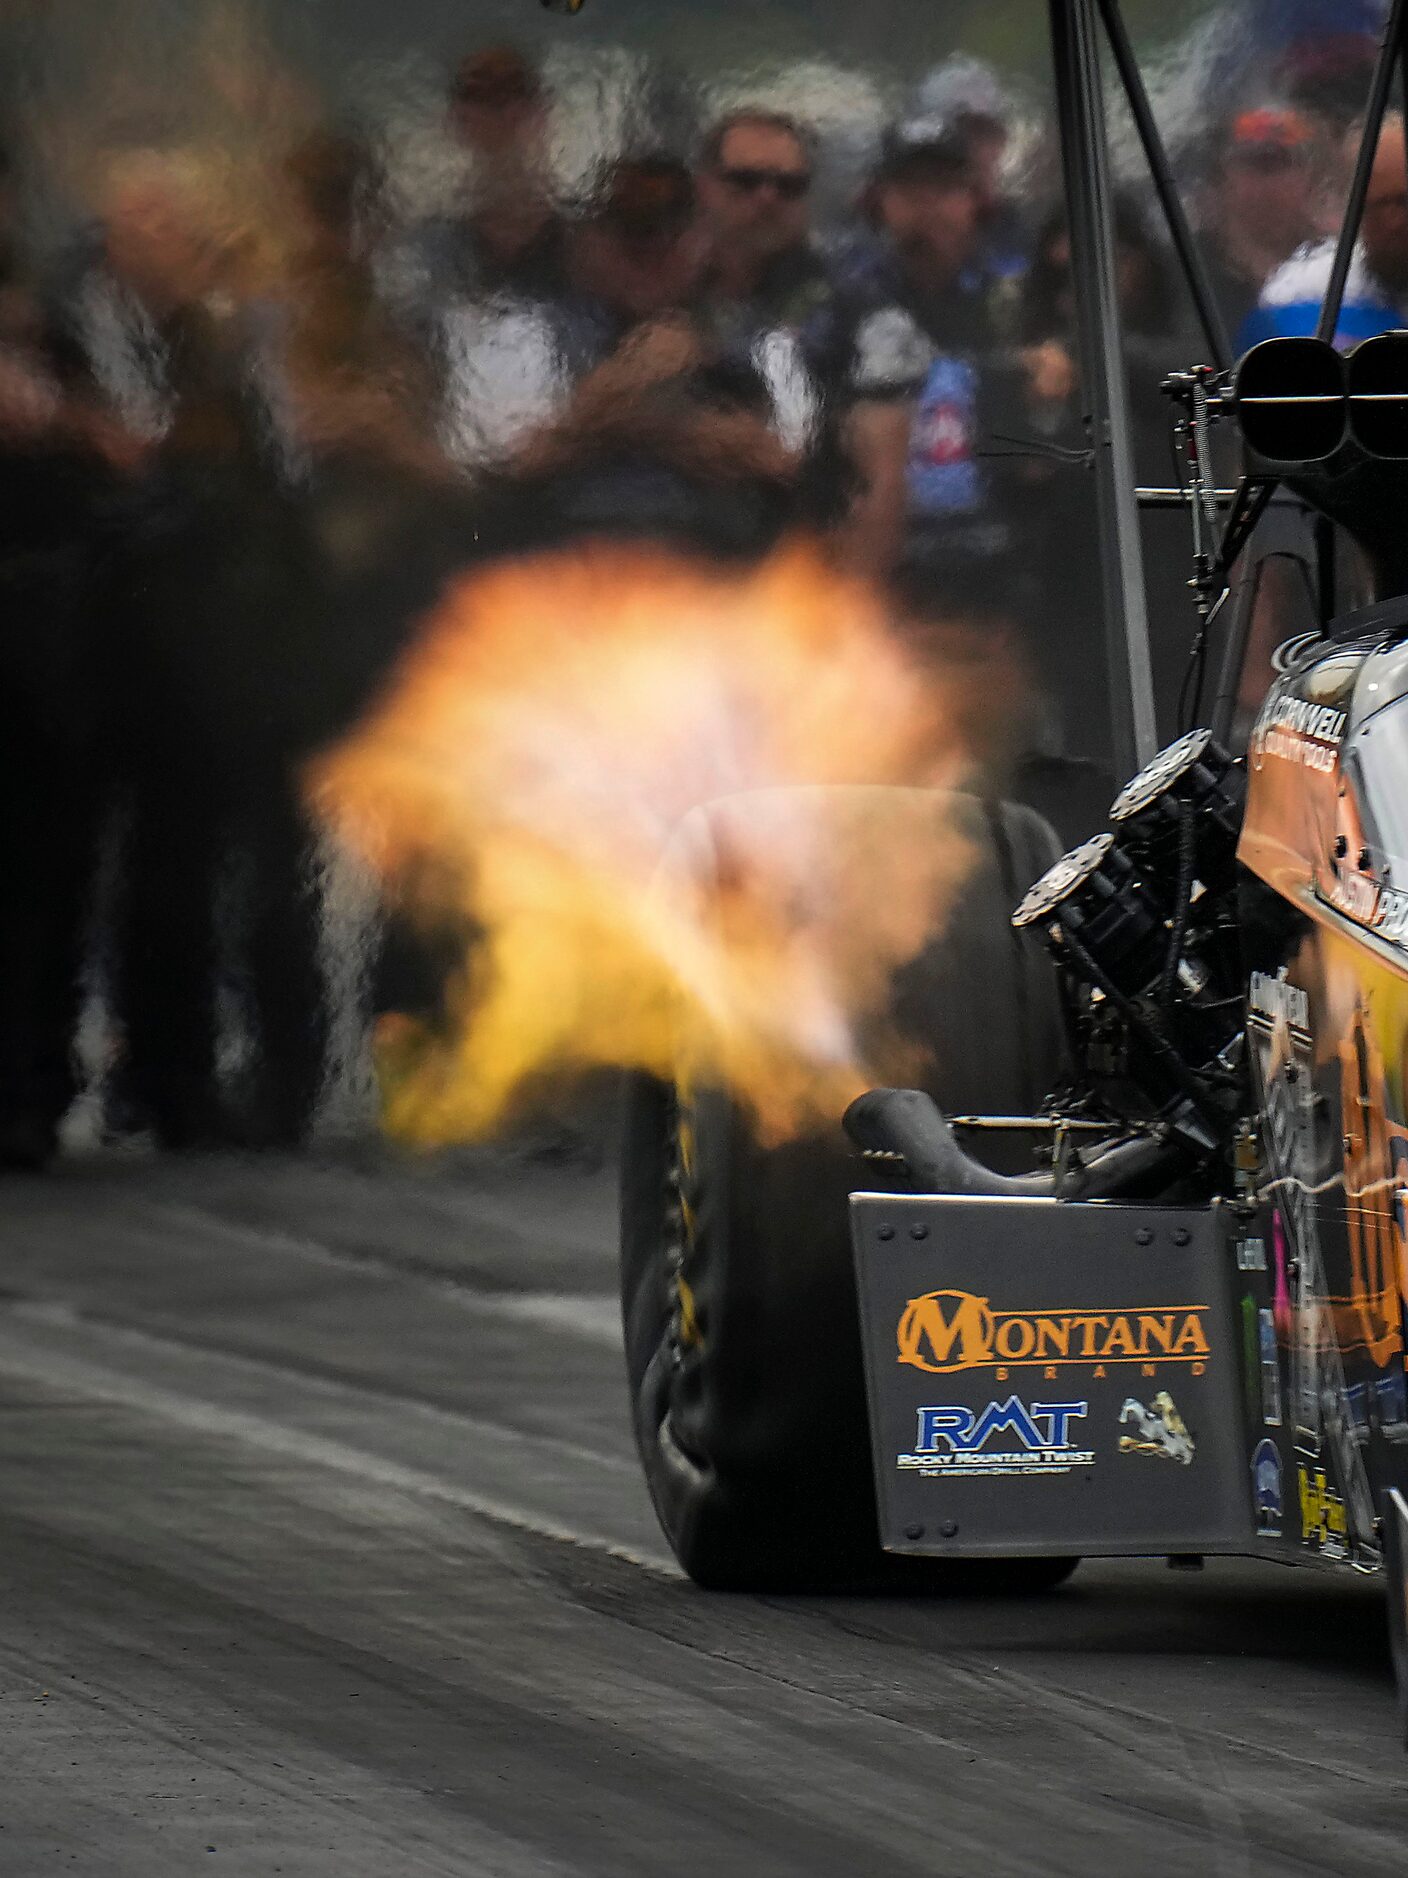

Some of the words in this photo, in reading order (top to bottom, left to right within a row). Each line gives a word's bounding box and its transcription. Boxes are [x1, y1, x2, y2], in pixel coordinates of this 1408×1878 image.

[897, 1290, 1212, 1370] MONTANA
[994, 1363, 1208, 1382] BRAND
[915, 1395, 1087, 1452] RMT
[897, 1453, 953, 1465] ROCKY
[955, 1452, 1040, 1464] MOUNTAIN
[1042, 1450, 1095, 1462] TWIST
